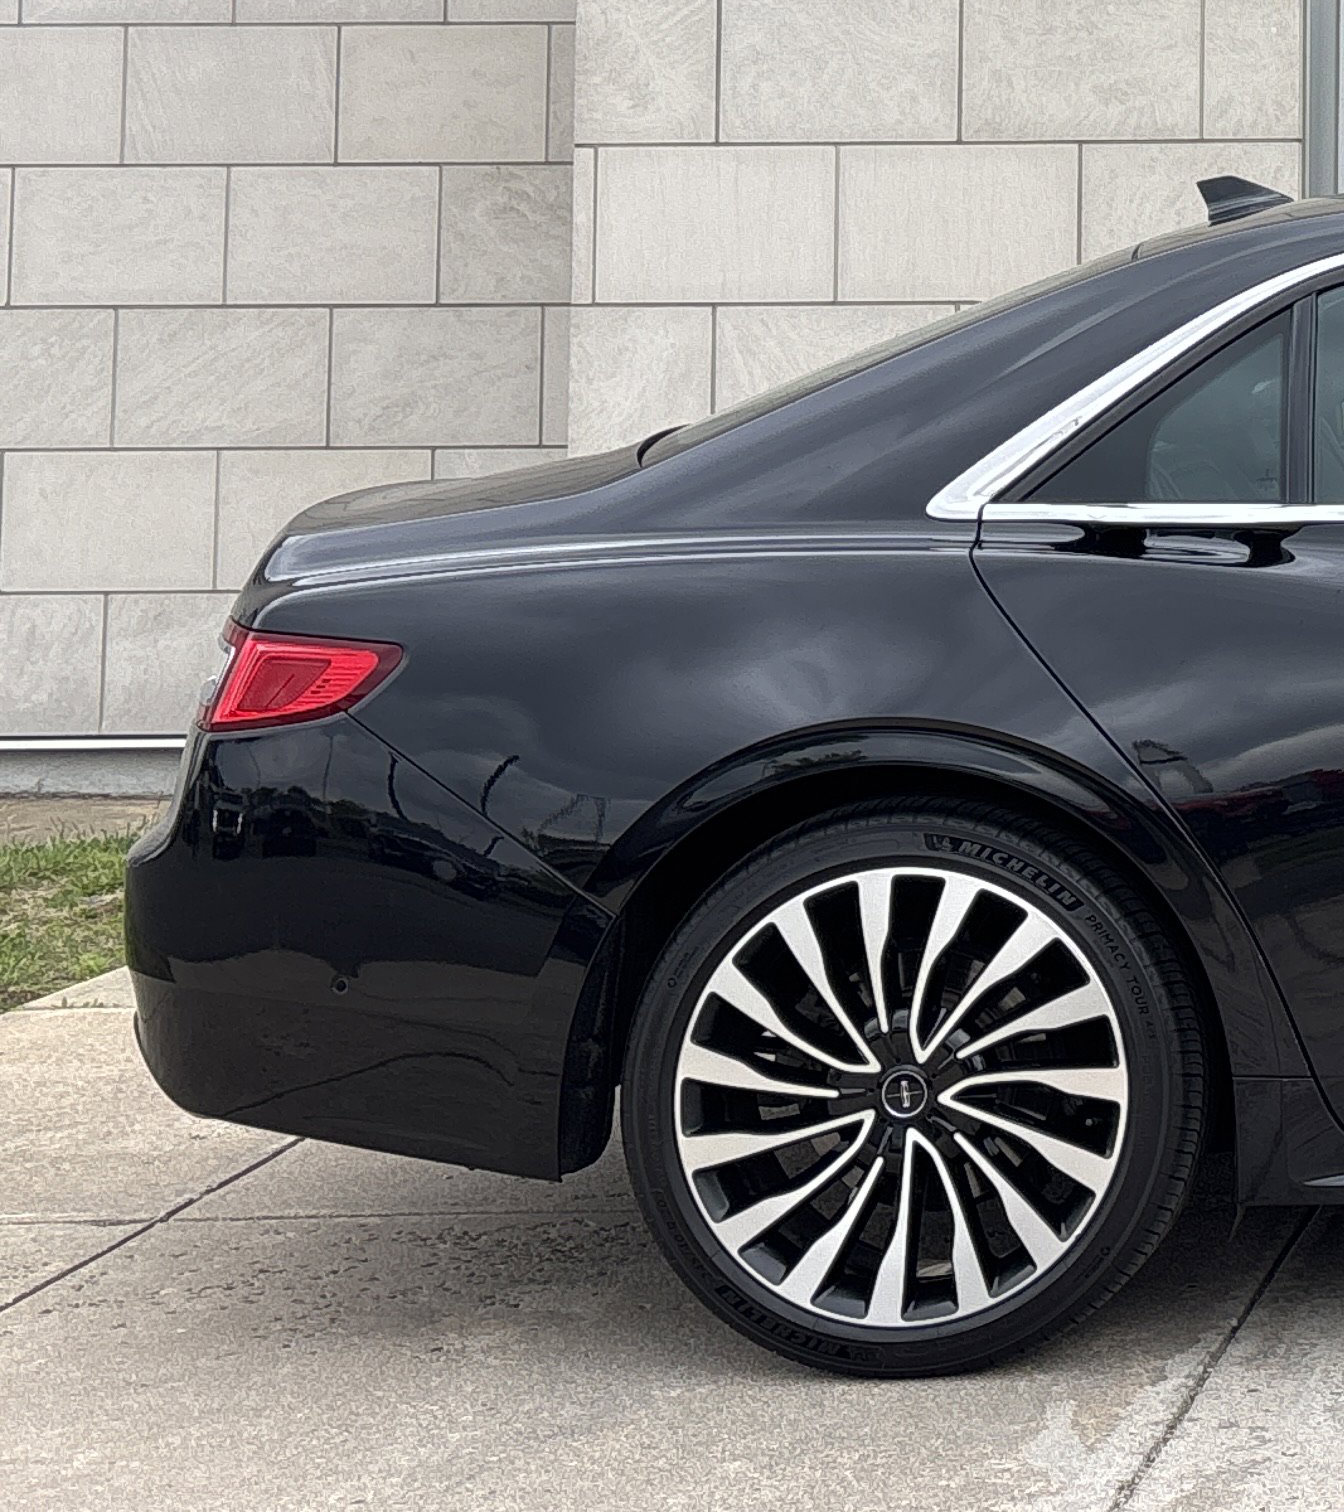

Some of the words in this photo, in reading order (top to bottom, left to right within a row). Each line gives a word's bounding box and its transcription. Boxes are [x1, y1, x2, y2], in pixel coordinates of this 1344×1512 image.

[959, 840, 1077, 907] MICHELIN
[1085, 914, 1132, 972] PRIMACY
[1126, 975, 1149, 1015] TOUR
